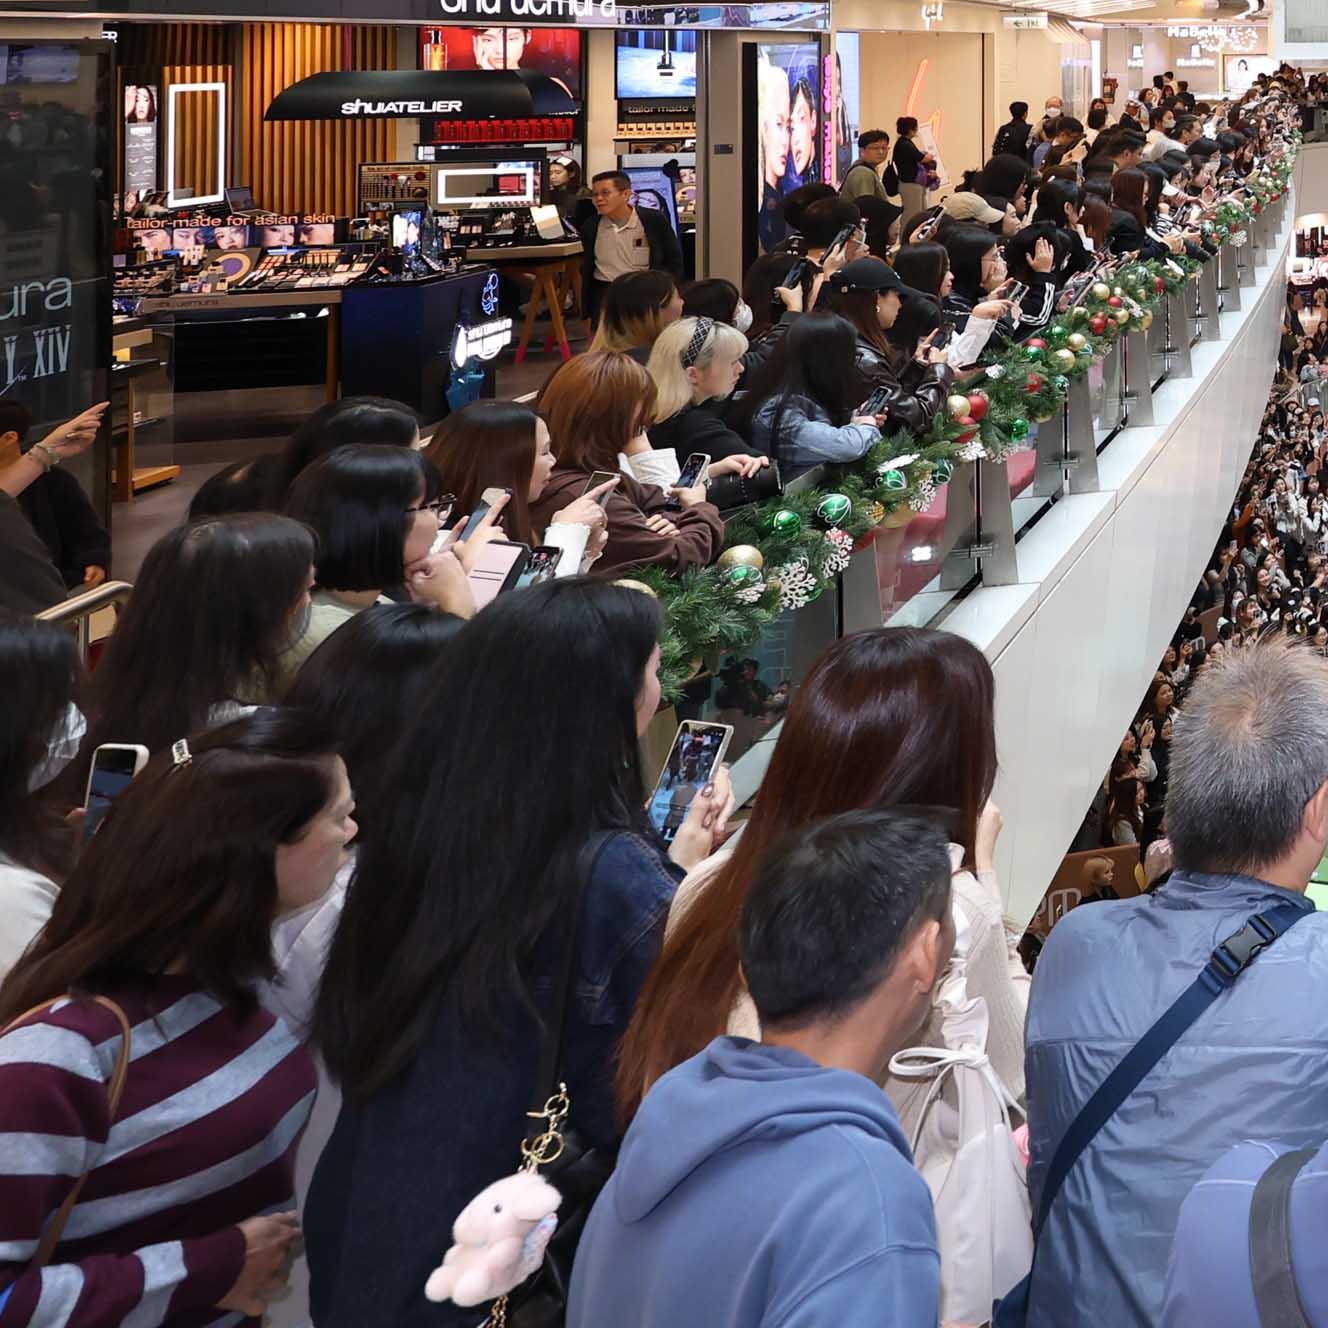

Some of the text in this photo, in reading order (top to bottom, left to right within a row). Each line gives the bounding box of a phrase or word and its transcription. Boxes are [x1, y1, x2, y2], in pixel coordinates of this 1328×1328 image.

[226, 213, 250, 227] for
[255, 213, 298, 225] asian
[303, 212, 336, 225] skin
[33, 325, 71, 379] XIV
